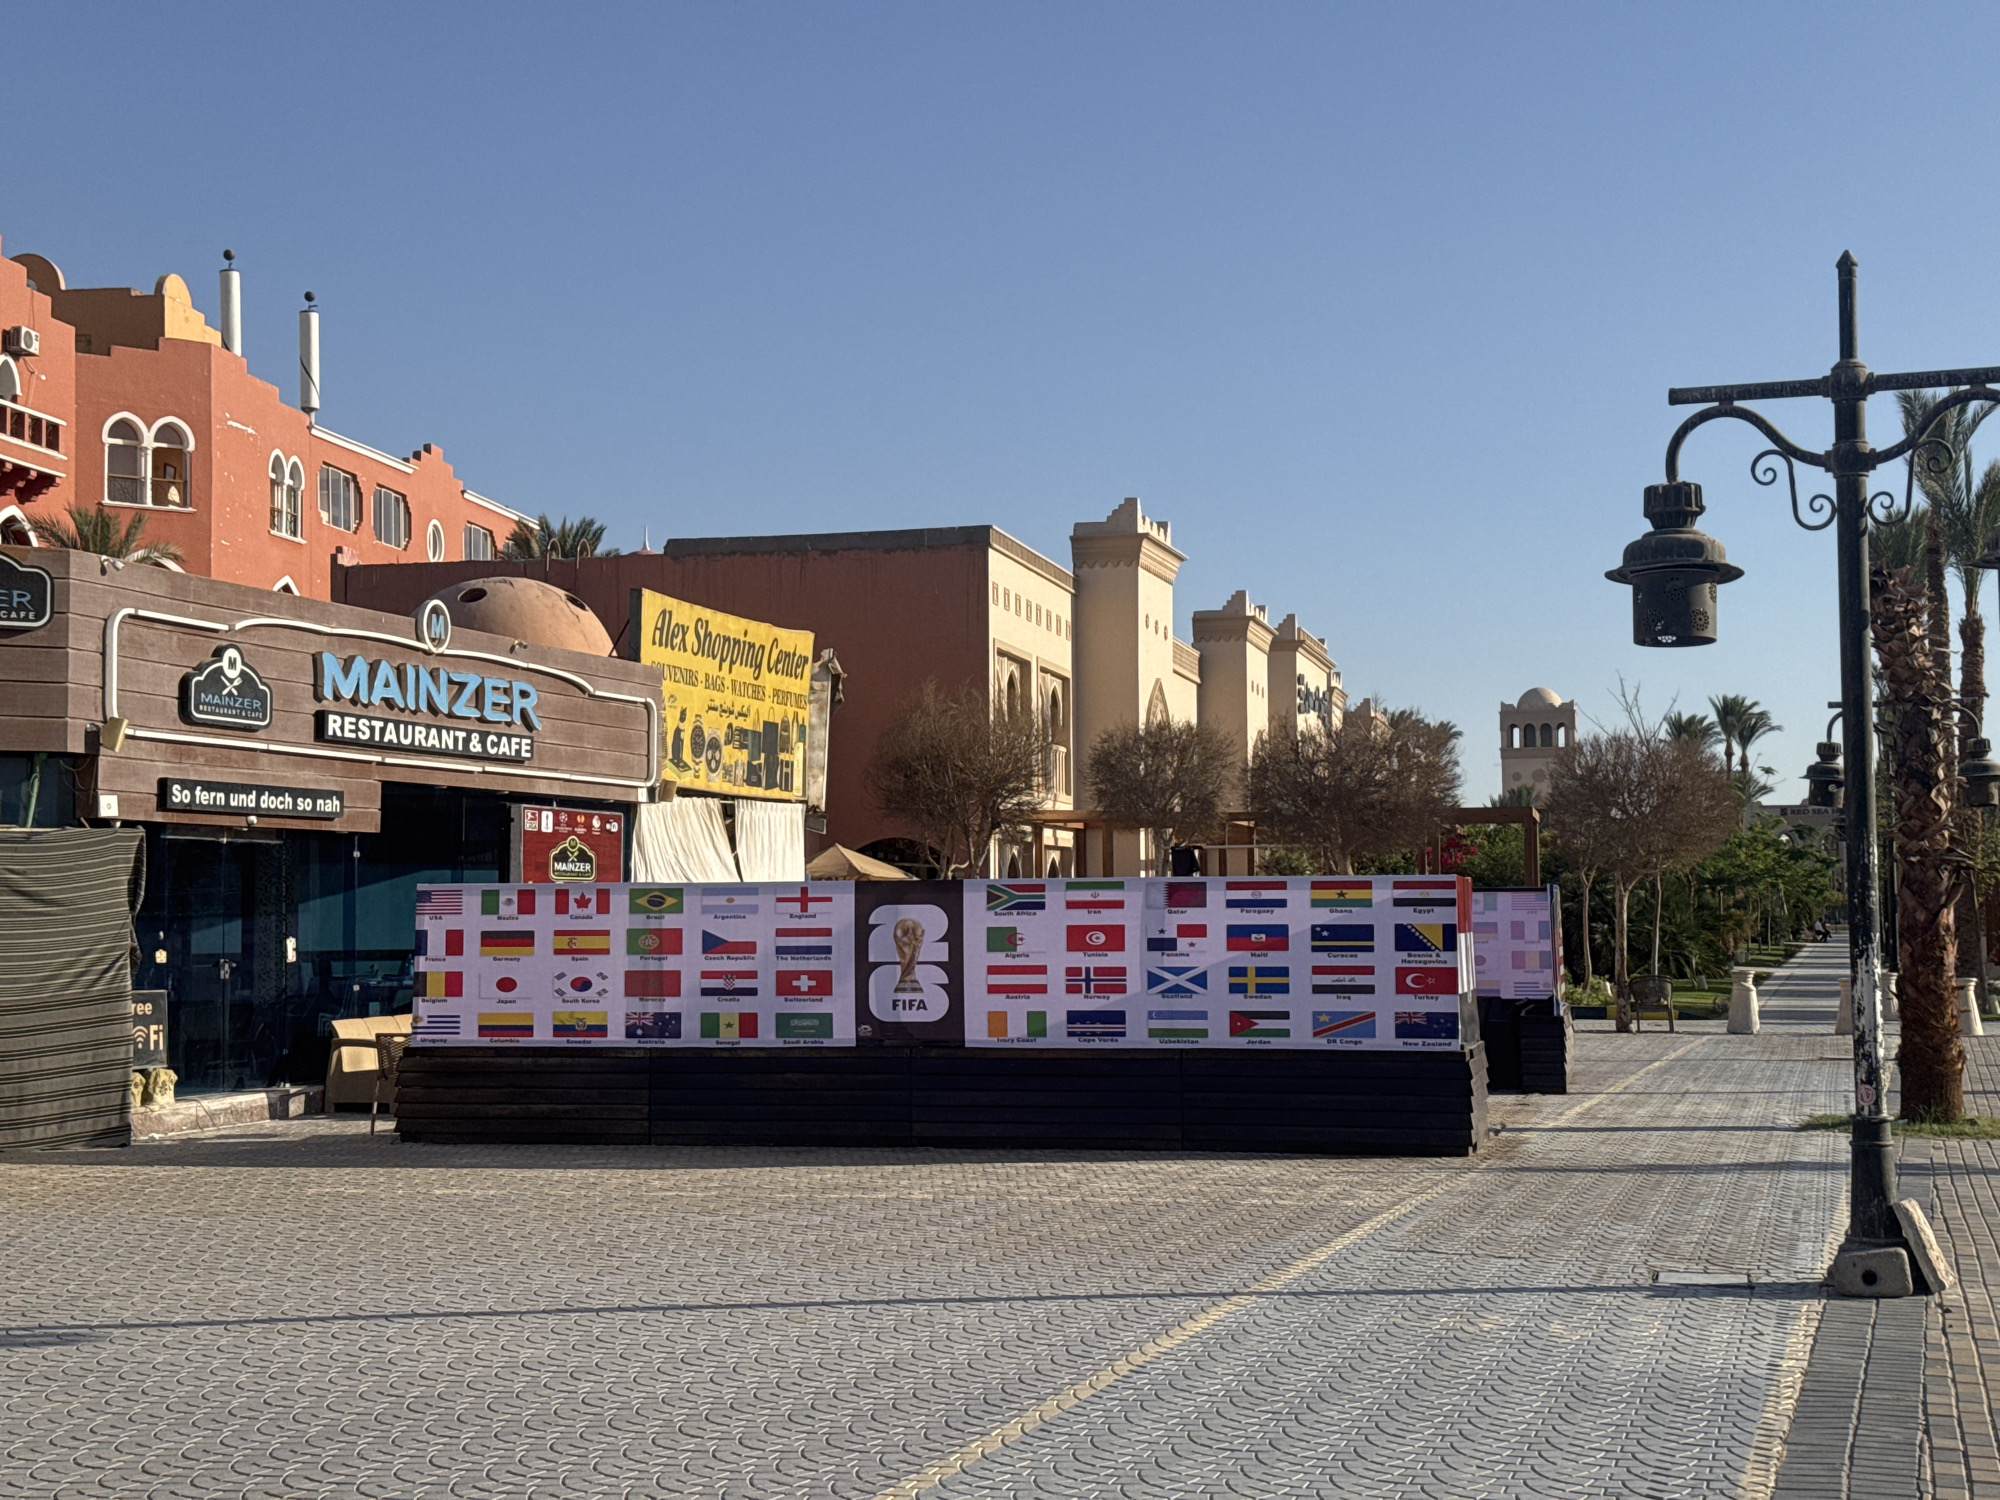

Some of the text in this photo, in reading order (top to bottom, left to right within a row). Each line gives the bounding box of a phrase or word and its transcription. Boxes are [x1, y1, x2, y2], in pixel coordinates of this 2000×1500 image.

[0, 610, 36, 620] CAFE
[431, 613, 445, 640] M
[652, 608, 809, 681] Alex Shopping Center
[228, 656, 237, 670] M
[200, 692, 262, 711] MAINZER
[322, 651, 542, 731] MAINZER
[704, 672, 726, 693] BAGS
[730, 678, 766, 702] WATCHES
[772, 688, 808, 710] PERFUMES
[199, 705, 240, 716] RESTAURANT
[247, 711, 263, 719] CAFE
[327, 714, 532, 758] RESTAURANT & CAFE
[171, 784, 341, 813] So fern und doch so nah
[554, 861, 591, 872] MAINZER
[892, 999, 928, 1011] FIFA
[149, 1024, 164, 1051] Fi
